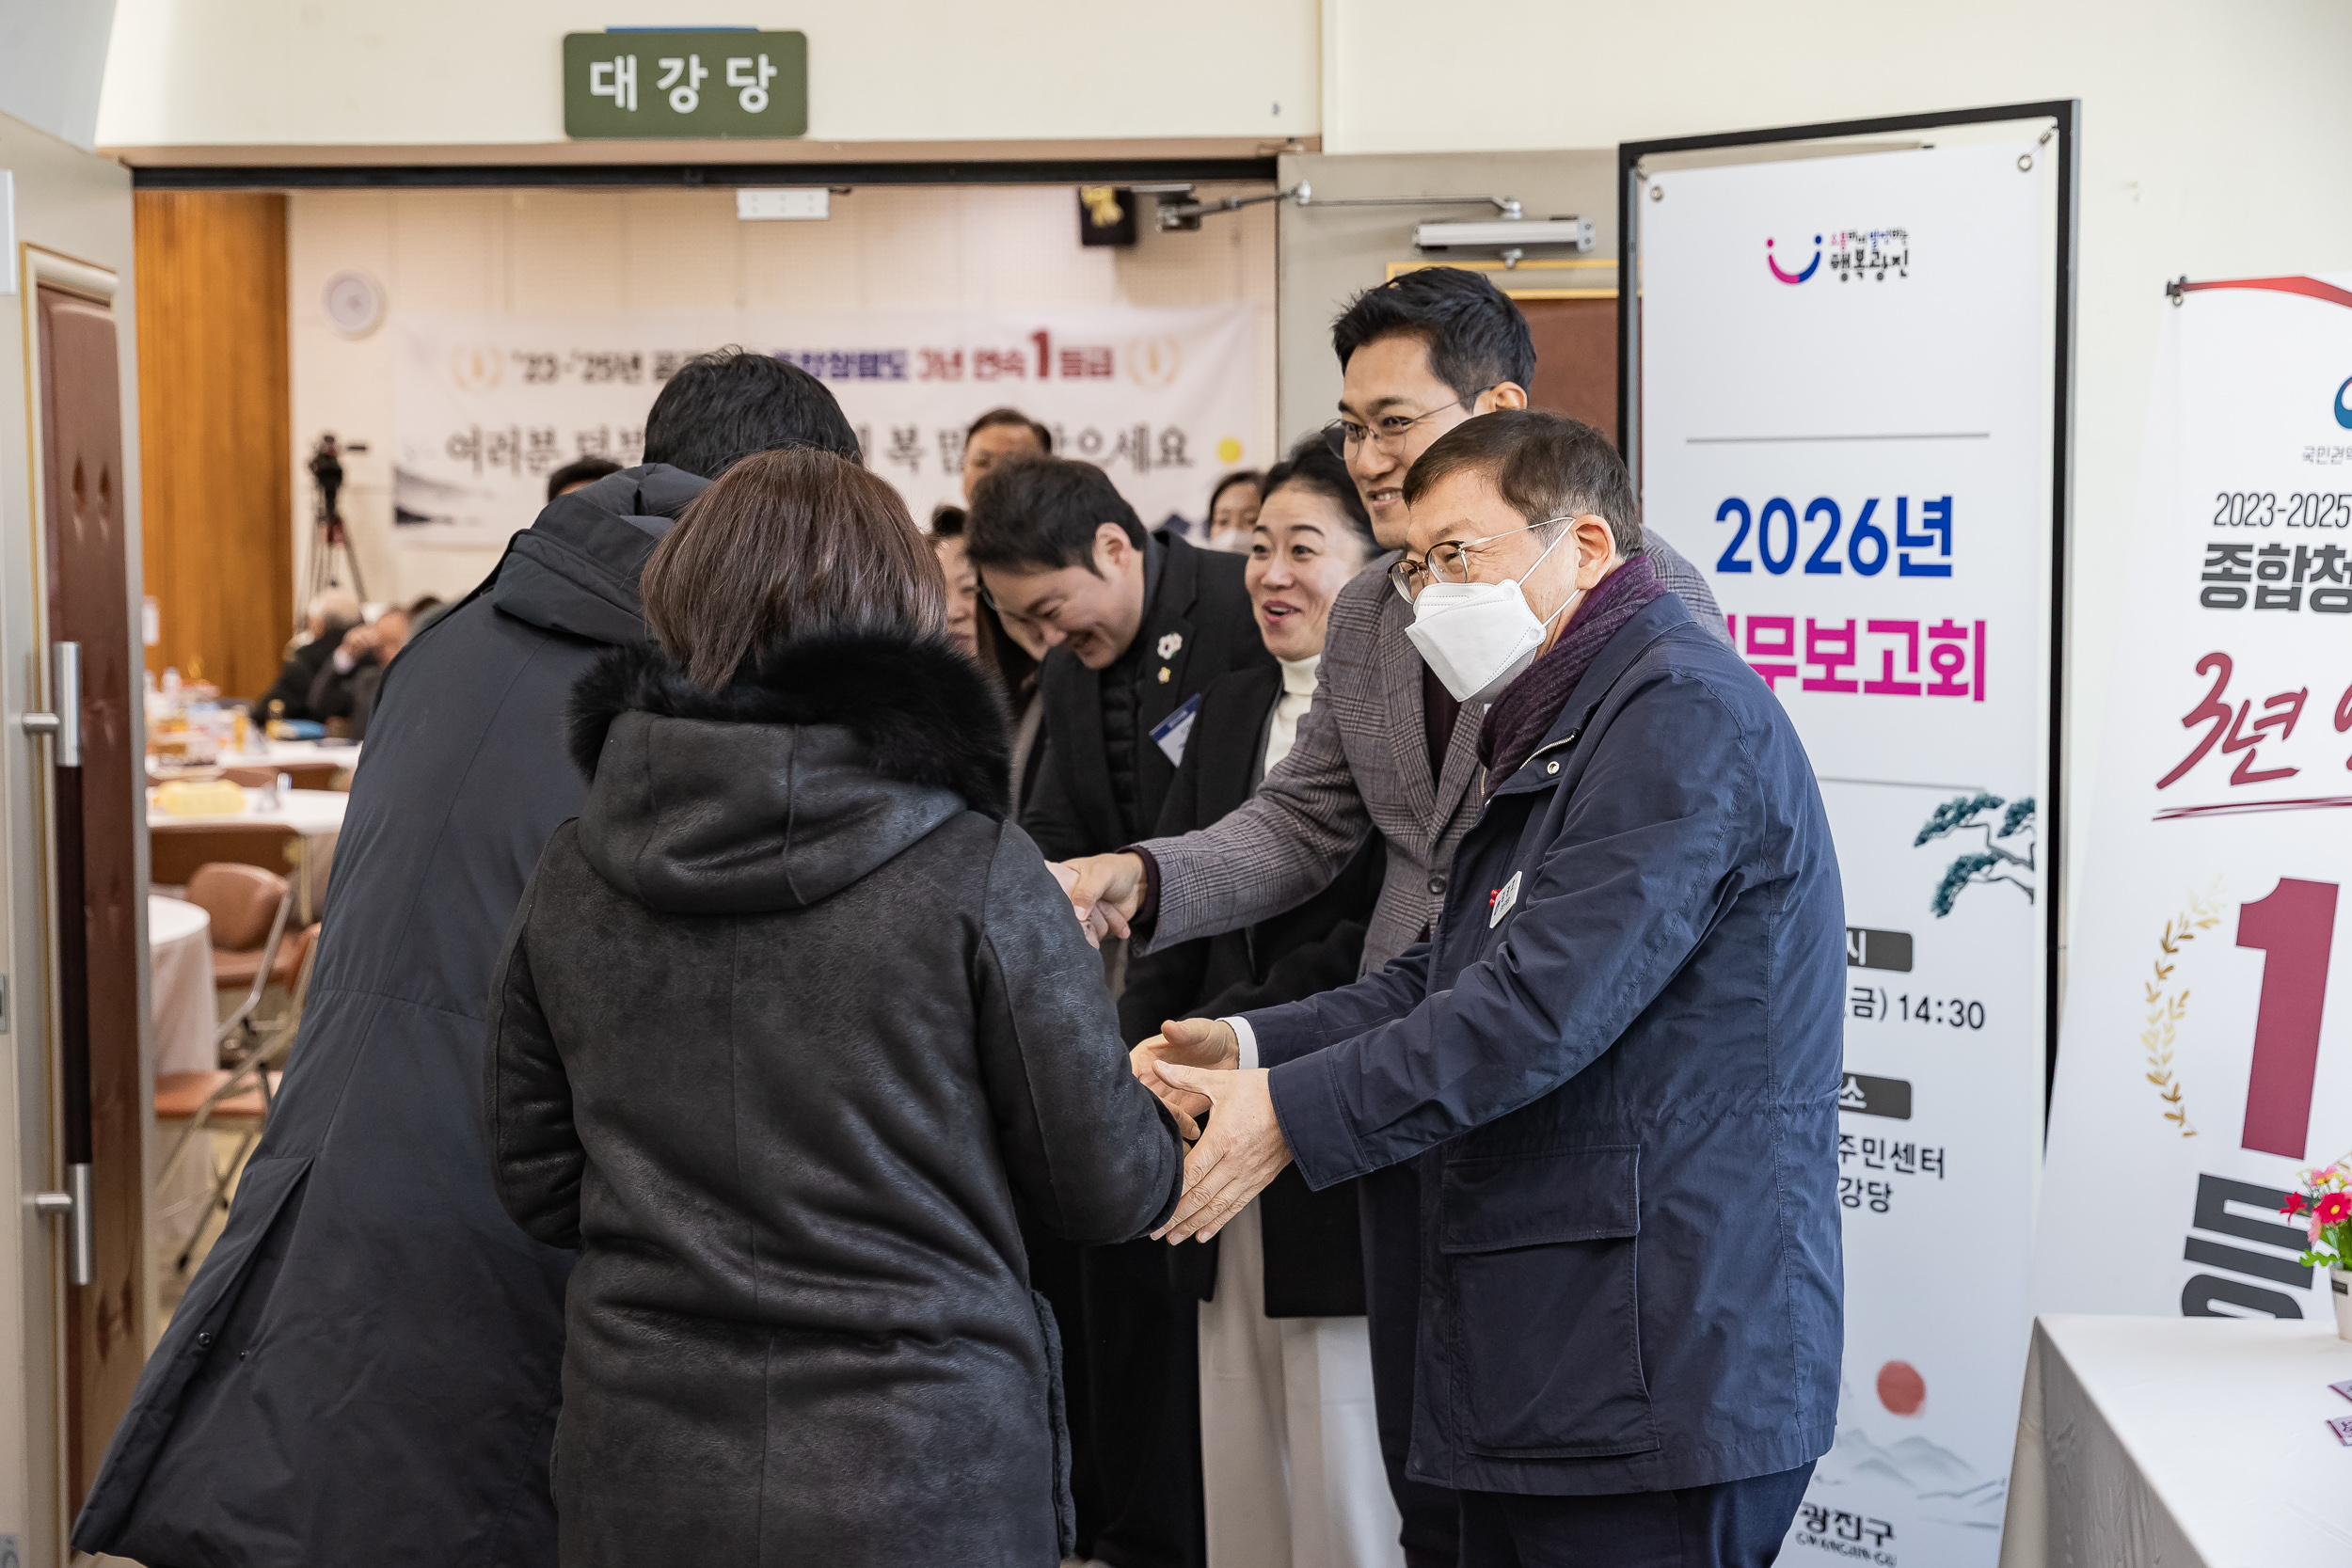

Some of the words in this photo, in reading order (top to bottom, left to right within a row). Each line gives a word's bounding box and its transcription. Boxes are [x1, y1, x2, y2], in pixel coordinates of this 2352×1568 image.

[590, 54, 777, 113] 대강당
[1831, 249, 1908, 281] 행복광진
[2214, 493, 2352, 528] 2023-2025
[1715, 495, 1953, 577] 2026년
[1726, 614, 1986, 702] 무보고회
[2156, 652, 2309, 786] 3년
[1845, 987, 1887, 1022] 금)
[1899, 994, 1985, 1029] 14:30
[1839, 1134, 1944, 1180] 주민센터
[1800, 1501, 1896, 1547] 광진구
